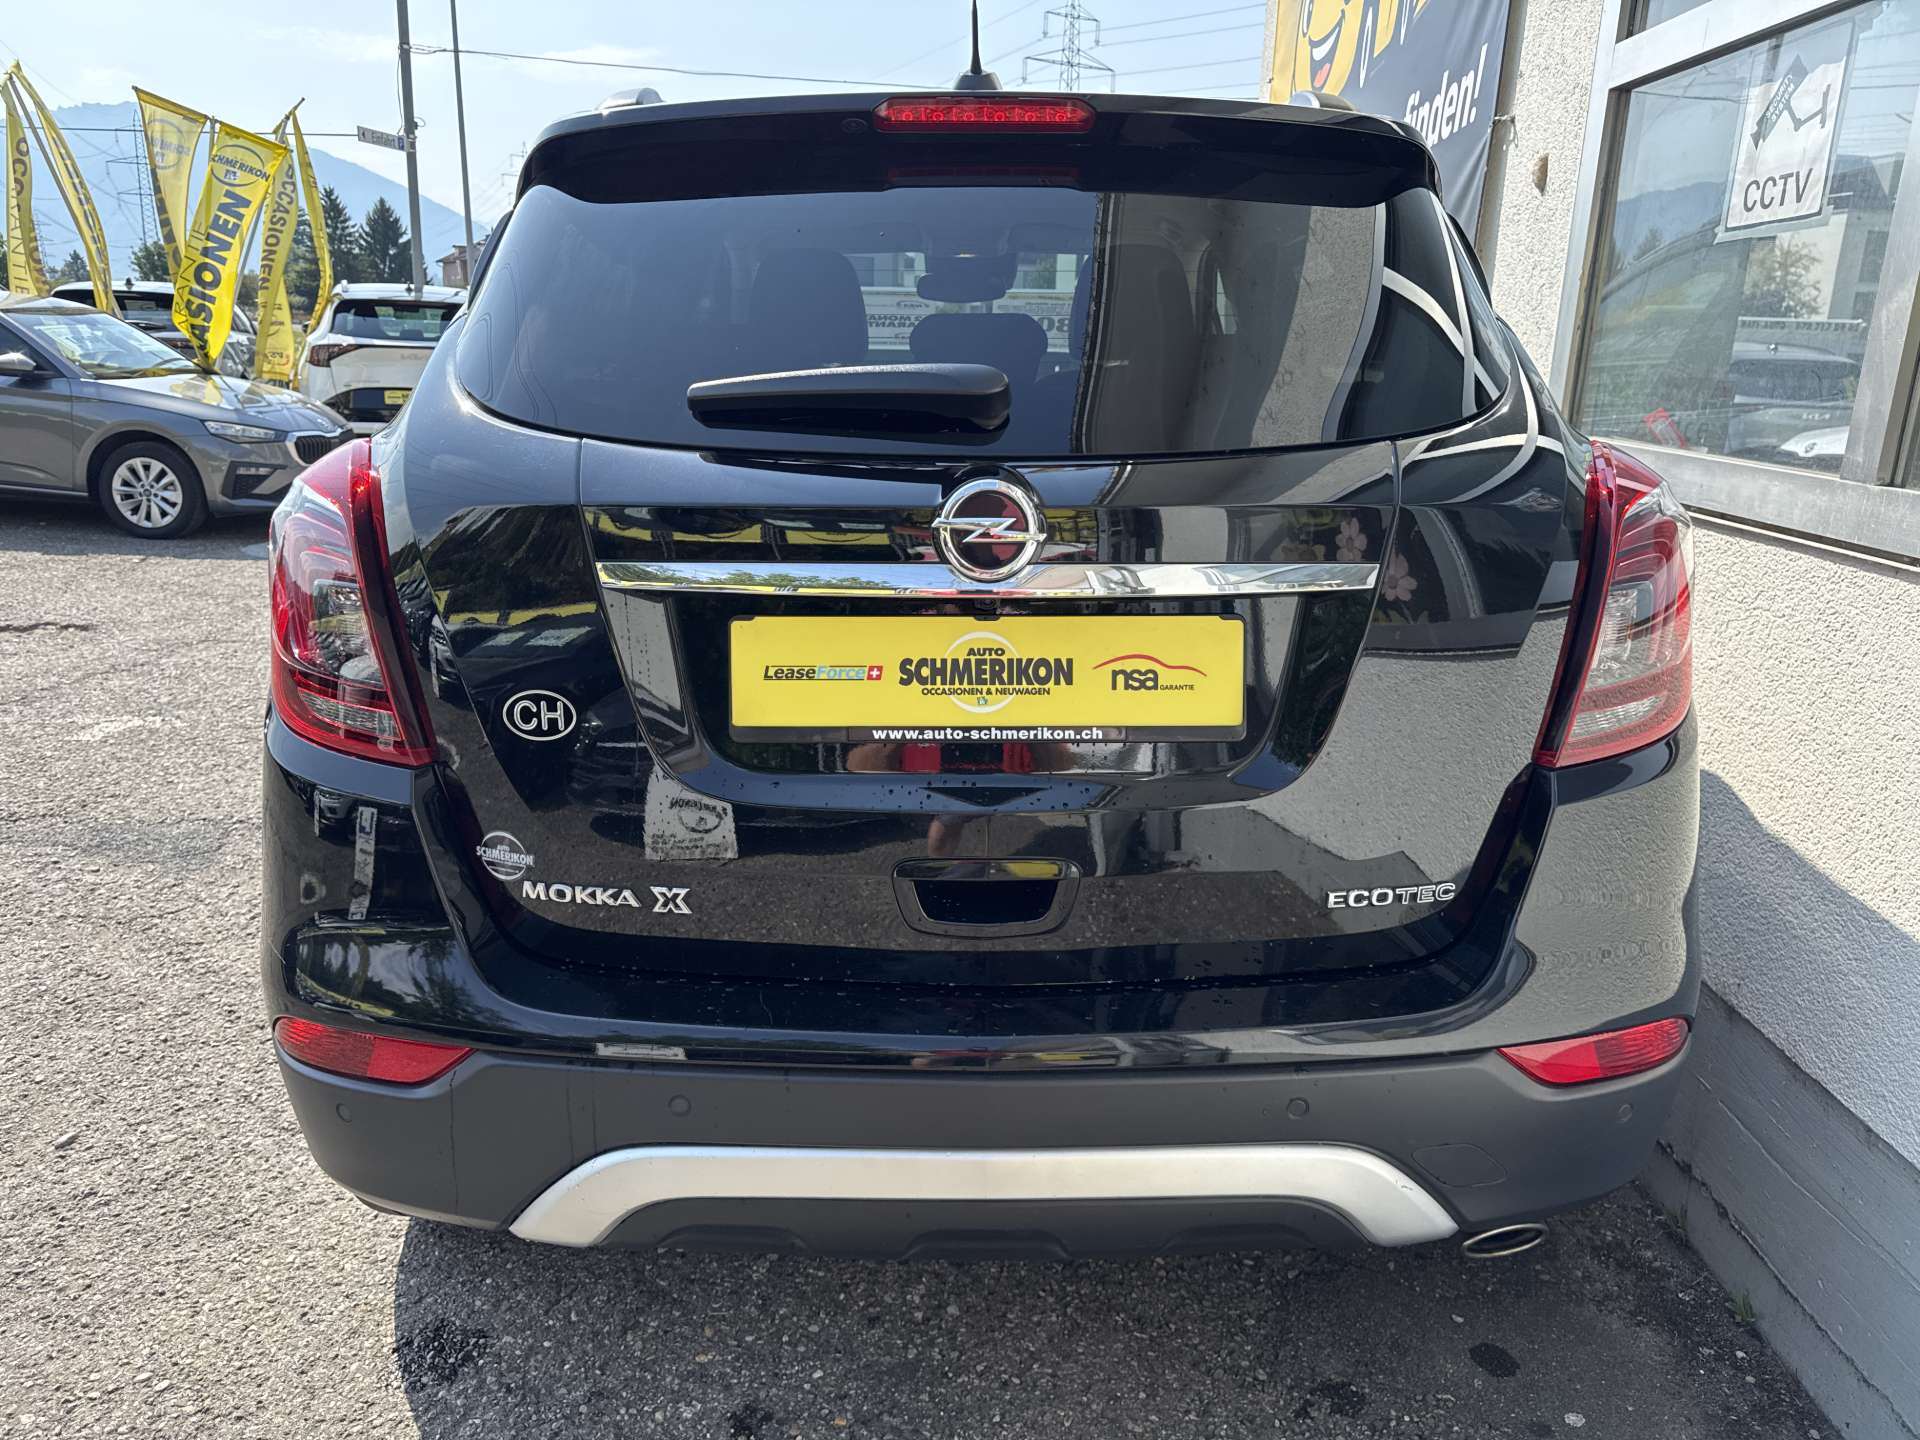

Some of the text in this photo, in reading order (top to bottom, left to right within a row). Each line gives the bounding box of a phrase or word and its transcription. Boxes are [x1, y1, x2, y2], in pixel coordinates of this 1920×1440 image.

[1404, 43, 1488, 148] finden!
[1771, 82, 1796, 122] SYSTEM
[1743, 168, 1813, 213] CCTV
[184, 189, 252, 350] ASIONEN
[966, 648, 1006, 657] AUTO
[763, 666, 867, 680] LeaseForce
[898, 657, 1073, 687] SCHMERIKON
[1111, 668, 1159, 691] nsa
[921, 687, 1050, 696] OCCASIONEN & NEUWAGEN
[513, 700, 566, 731] CH
[872, 727, 1103, 740] www.auto-schmerikon.ch
[476, 845, 534, 867] SCHMERIKON
[522, 880, 693, 914] MOKKA X
[1327, 882, 1456, 908] ECOTEC
